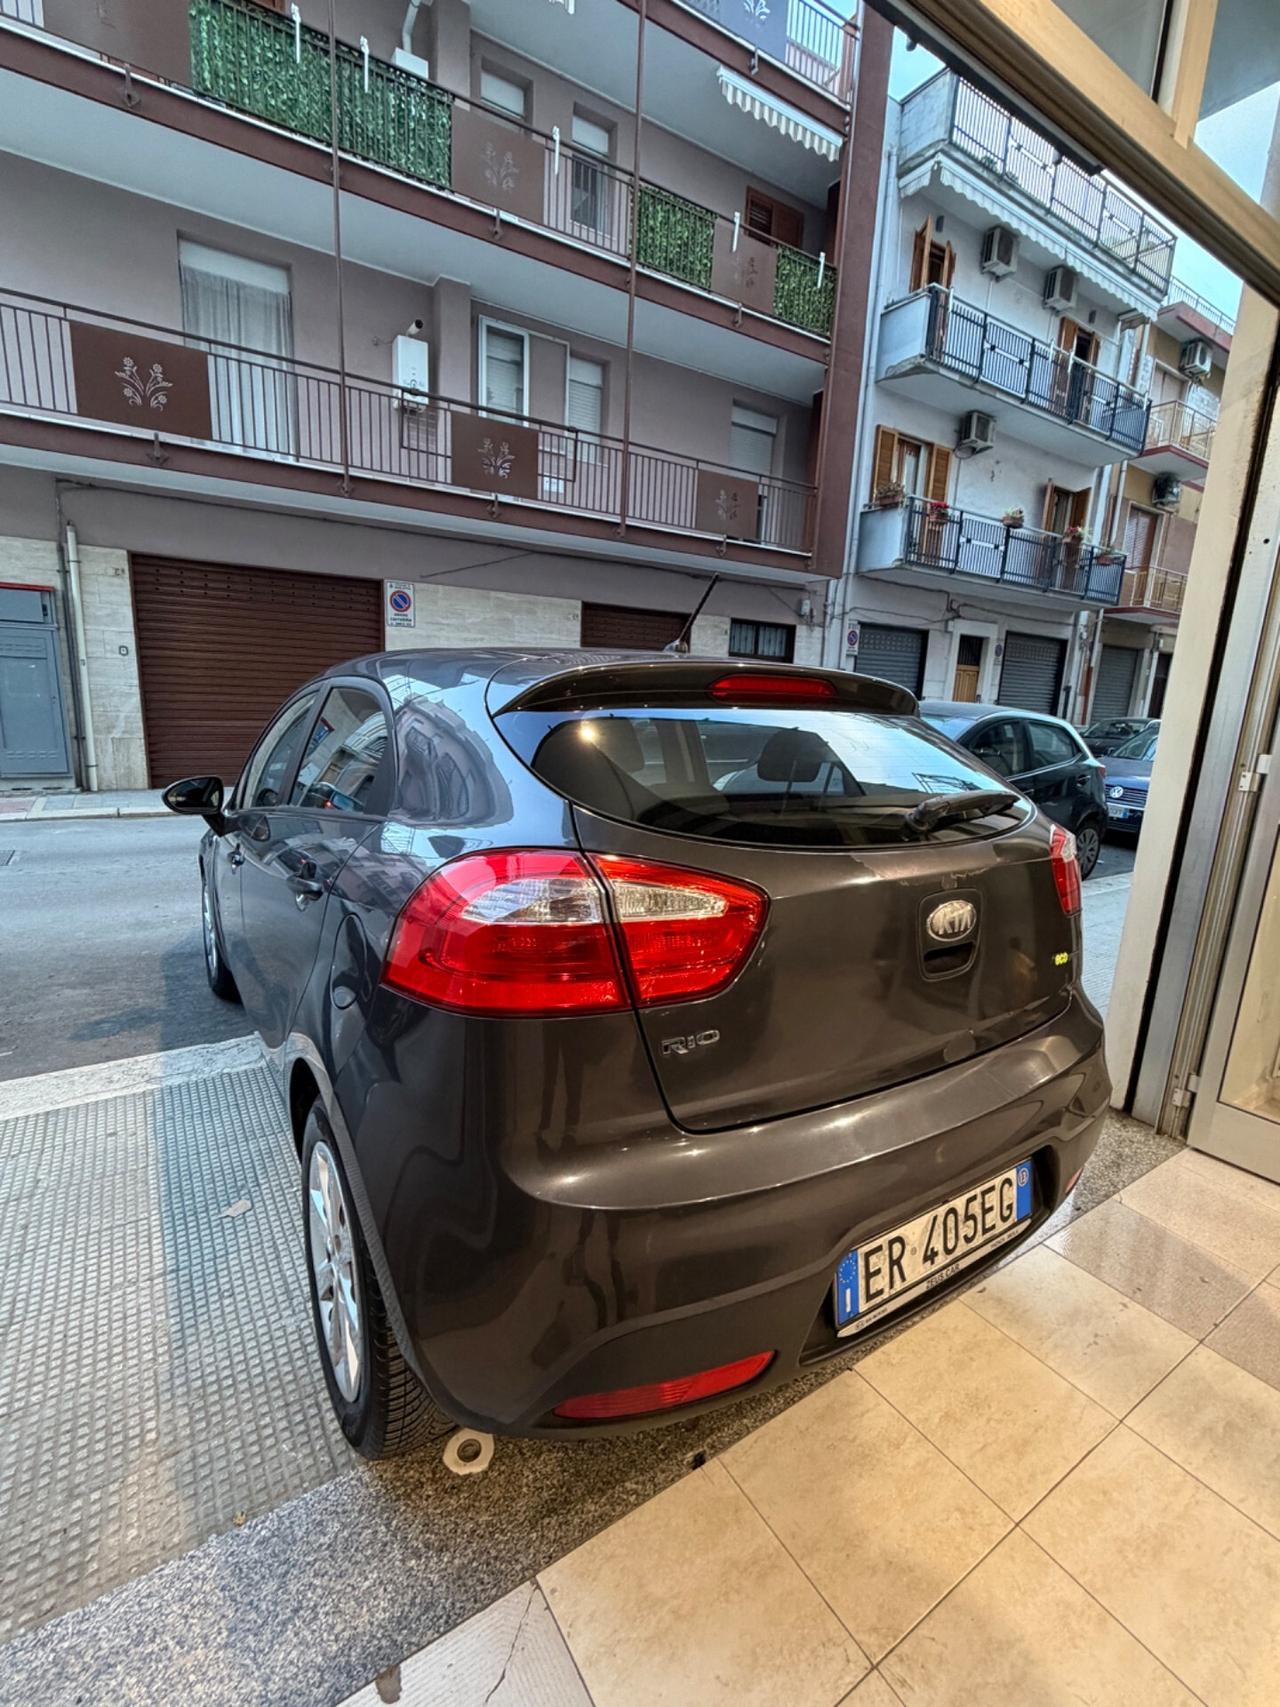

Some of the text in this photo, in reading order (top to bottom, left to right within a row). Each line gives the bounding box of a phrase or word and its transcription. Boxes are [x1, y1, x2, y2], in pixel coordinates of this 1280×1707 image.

[929, 900, 976, 939] KIA
[661, 1030, 720, 1055] RIO
[863, 1177, 1014, 1303] ER 405EG
